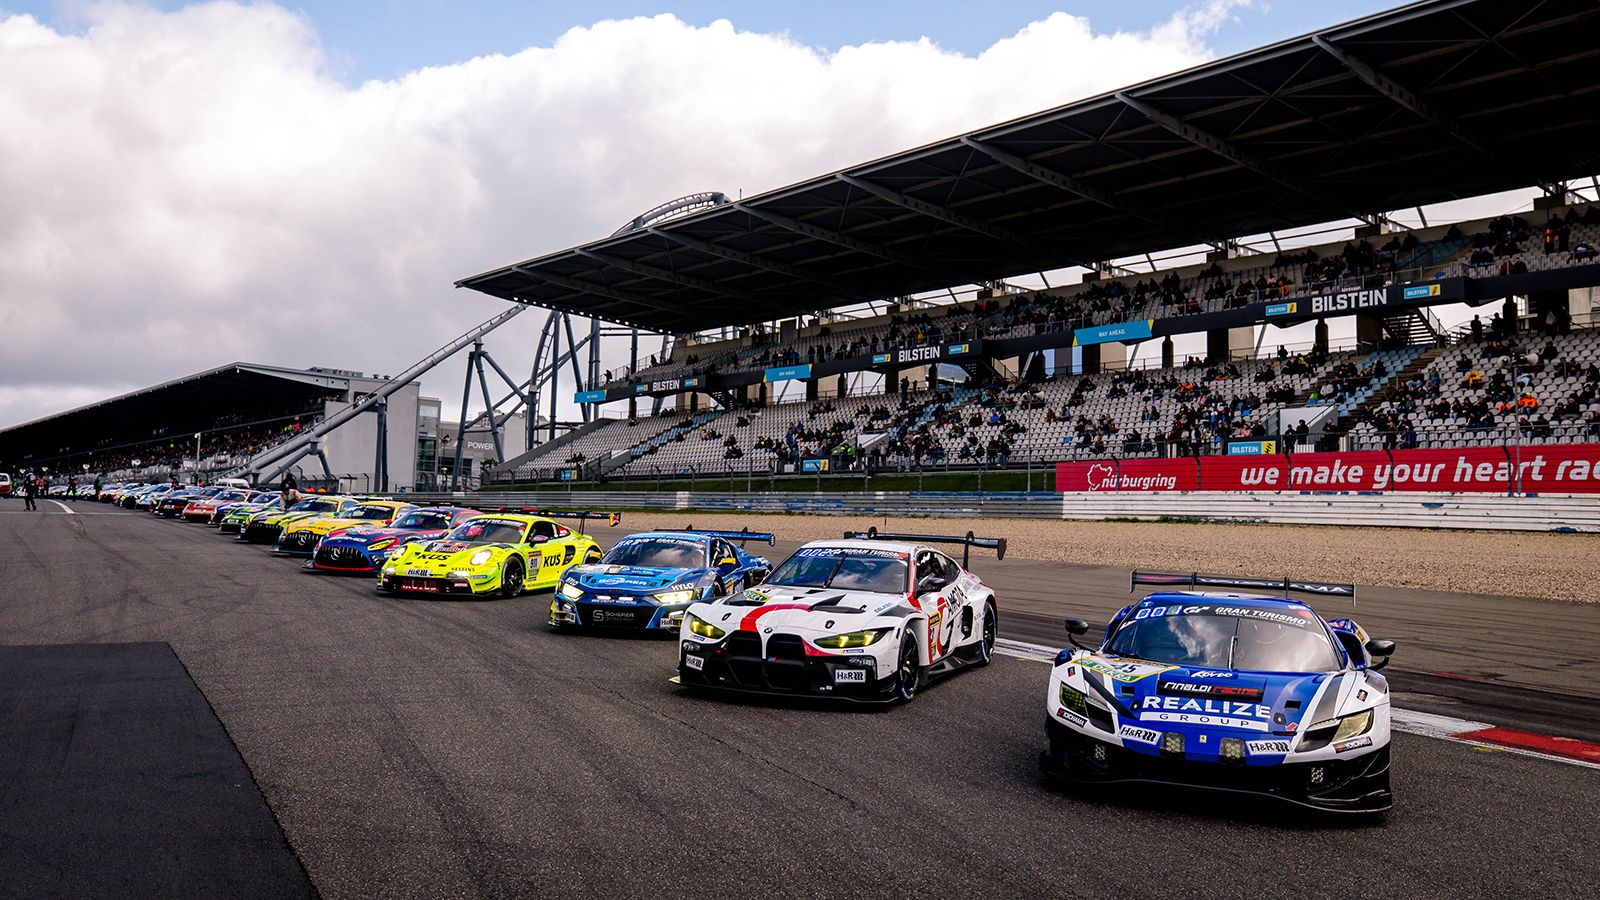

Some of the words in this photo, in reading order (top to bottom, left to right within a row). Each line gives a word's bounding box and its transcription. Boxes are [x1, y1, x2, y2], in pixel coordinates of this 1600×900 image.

[1312, 288, 1387, 313] BILSTEIN
[898, 346, 940, 363] BILSTEIN
[652, 380, 680, 392] BILSTEIN
[467, 441, 494, 450] POWER
[1231, 445, 1259, 454] BILSTEIN
[1241, 467, 1279, 485] we
[1291, 459, 1364, 485] make
[1372, 462, 1446, 489] your
[1453, 455, 1547, 482] heart
[1101, 473, 1177, 490] nürburgring
[543, 554, 561, 568] KUS
[671, 582, 695, 591] HYLO
[1214, 606, 1250, 615] GRAN
[1252, 609, 1308, 625] TURISMO
[1142, 696, 1271, 719] REALIZE
[1159, 713, 1250, 727] GROUP
